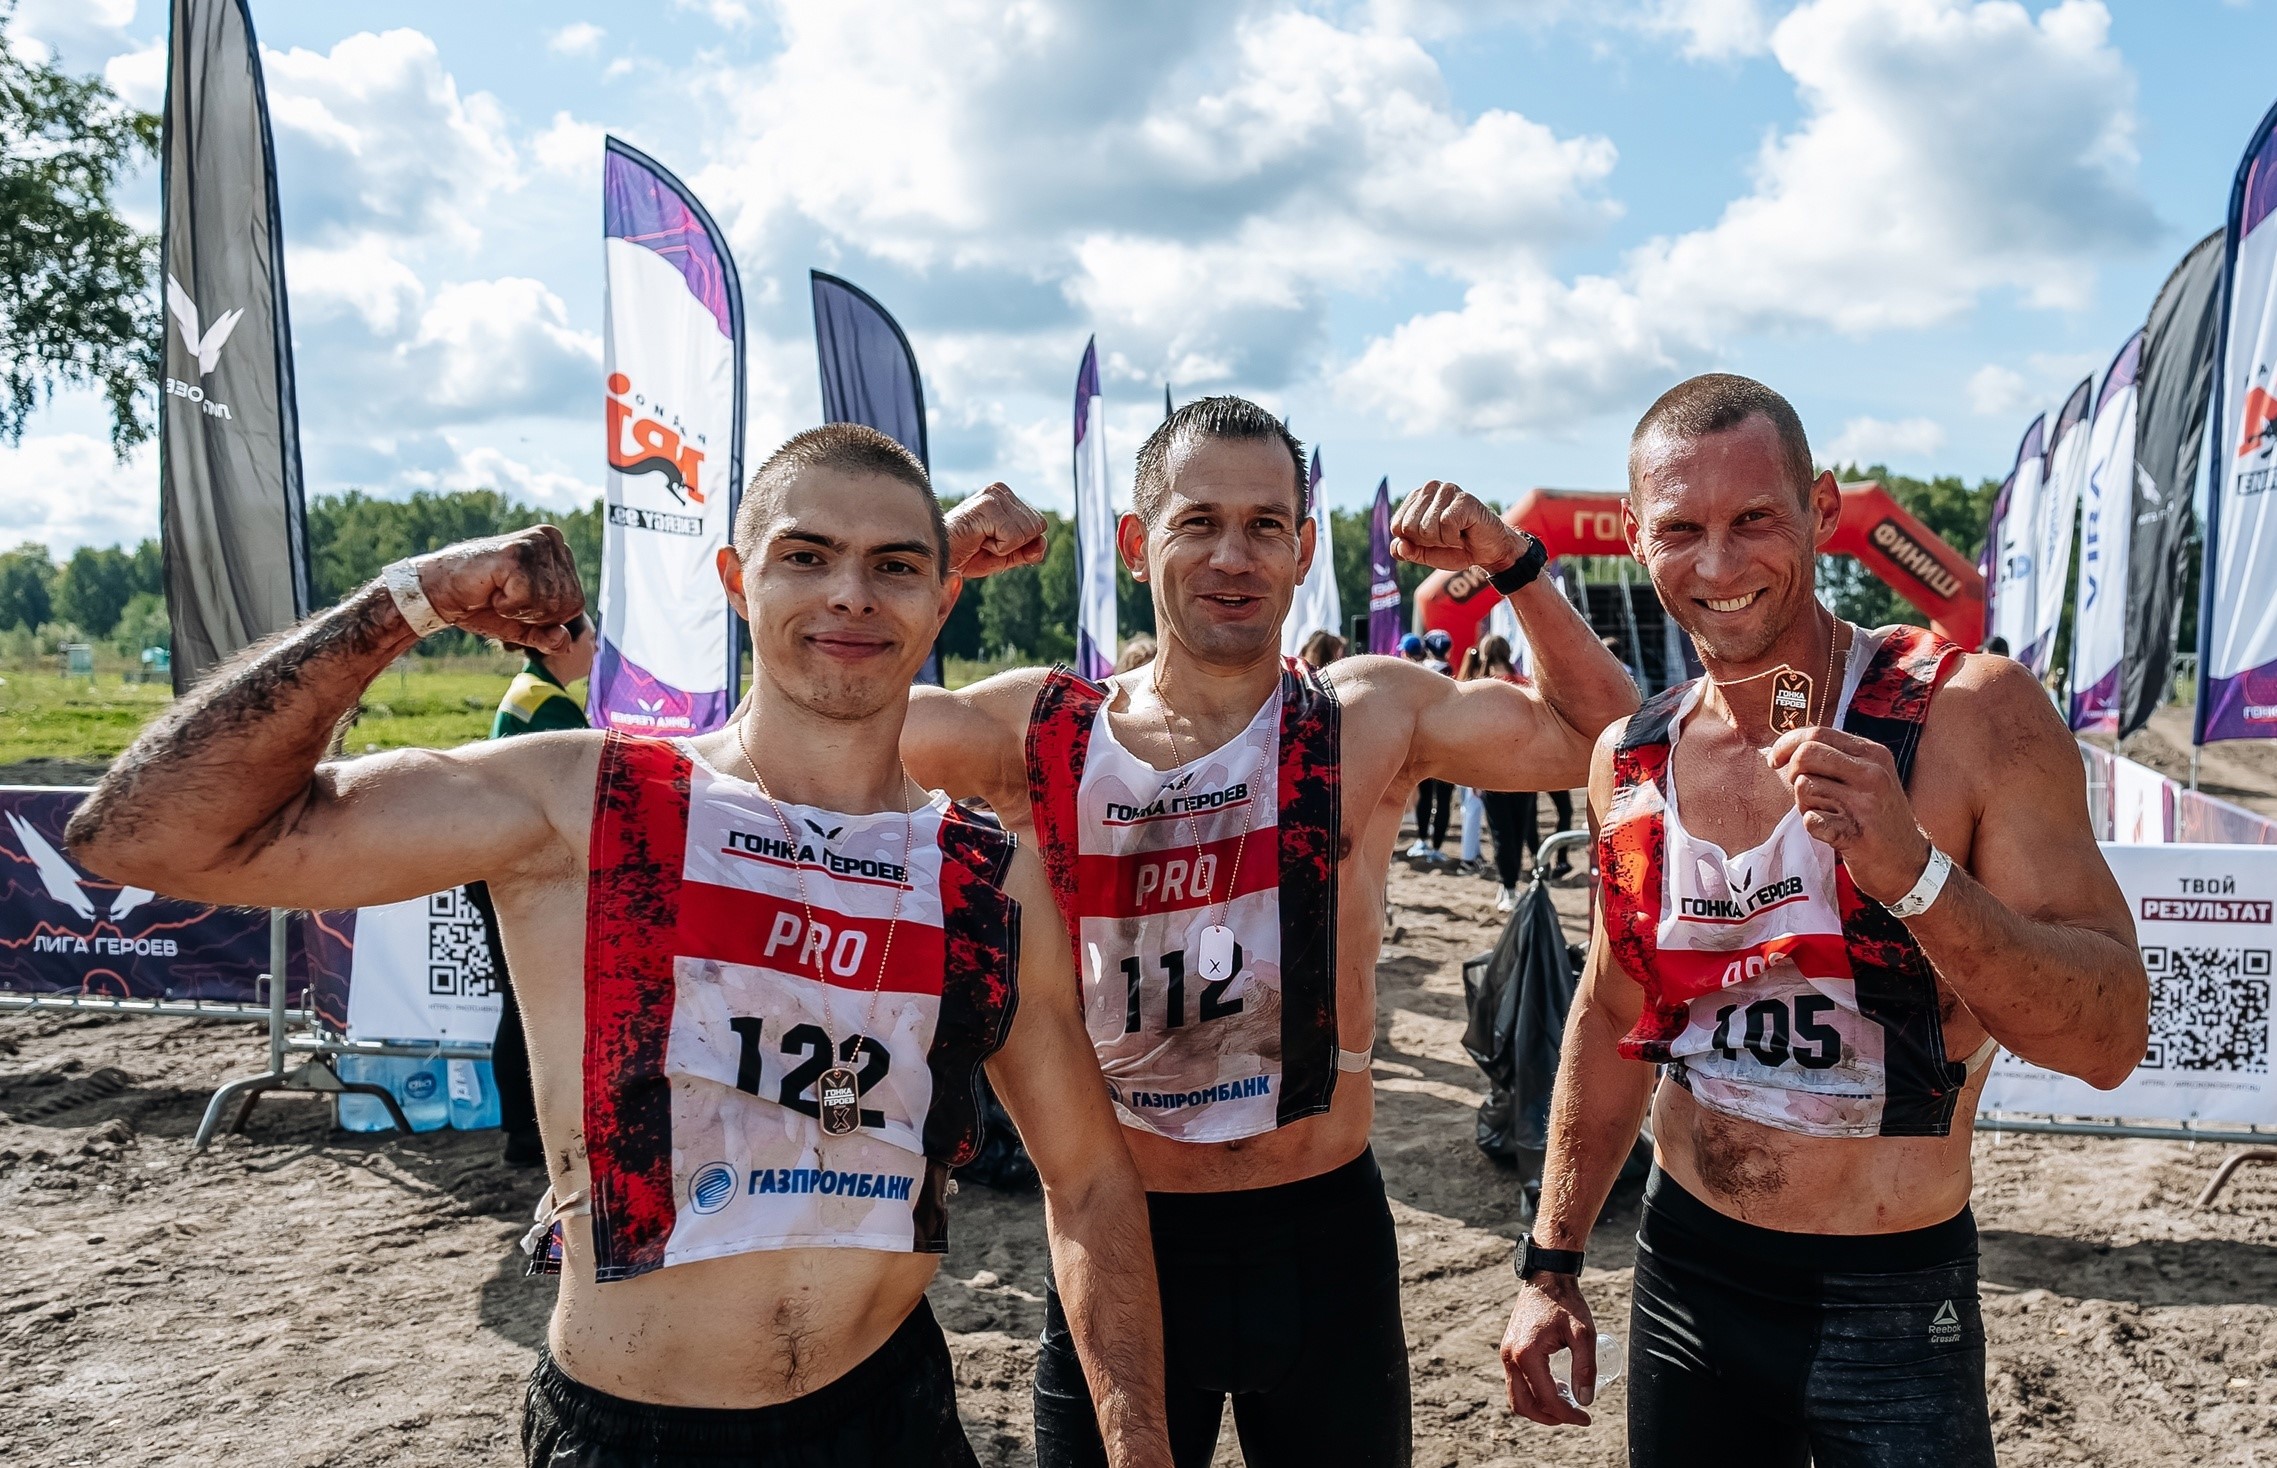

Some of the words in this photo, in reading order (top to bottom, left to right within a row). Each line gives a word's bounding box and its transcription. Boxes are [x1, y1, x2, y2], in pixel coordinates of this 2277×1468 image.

[1874, 523, 1962, 598] ФИНИШ
[1775, 699, 1806, 709] ГЕРОЕВ
[1779, 690, 1805, 699] ГОНКА
[1107, 799, 1165, 821] ГОНКА
[1172, 783, 1247, 813] ГЕРОЕВ
[728, 830, 815, 862] ГОНКА
[822, 847, 908, 882] ГЕРОЕВ
[1135, 853, 1218, 907] PRO
[1681, 897, 1746, 918] ГОНКА
[1747, 876, 1804, 912] ГЕРОЕВ
[2179, 875, 2236, 894] ТВОЙ
[2144, 901, 2270, 921] РЕЗУЛЬТАТ
[33, 935, 90, 954] ЛИГА
[95, 937, 178, 957] ГЕРОЕВ
[763, 911, 868, 977] PRO
[1120, 941, 1243, 1034] 112
[1712, 994, 1842, 1070] 105
[729, 1016, 891, 1129] 122
[824, 1097, 855, 1107] ГЕРОЕВ
[825, 1088, 852, 1097] ГОНКА
[1132, 1075, 1270, 1109] ГАЗПРОМБАНК
[748, 1168, 914, 1201] ГАЗПРОМБАНК
[1928, 1324, 1962, 1334] Reebok
